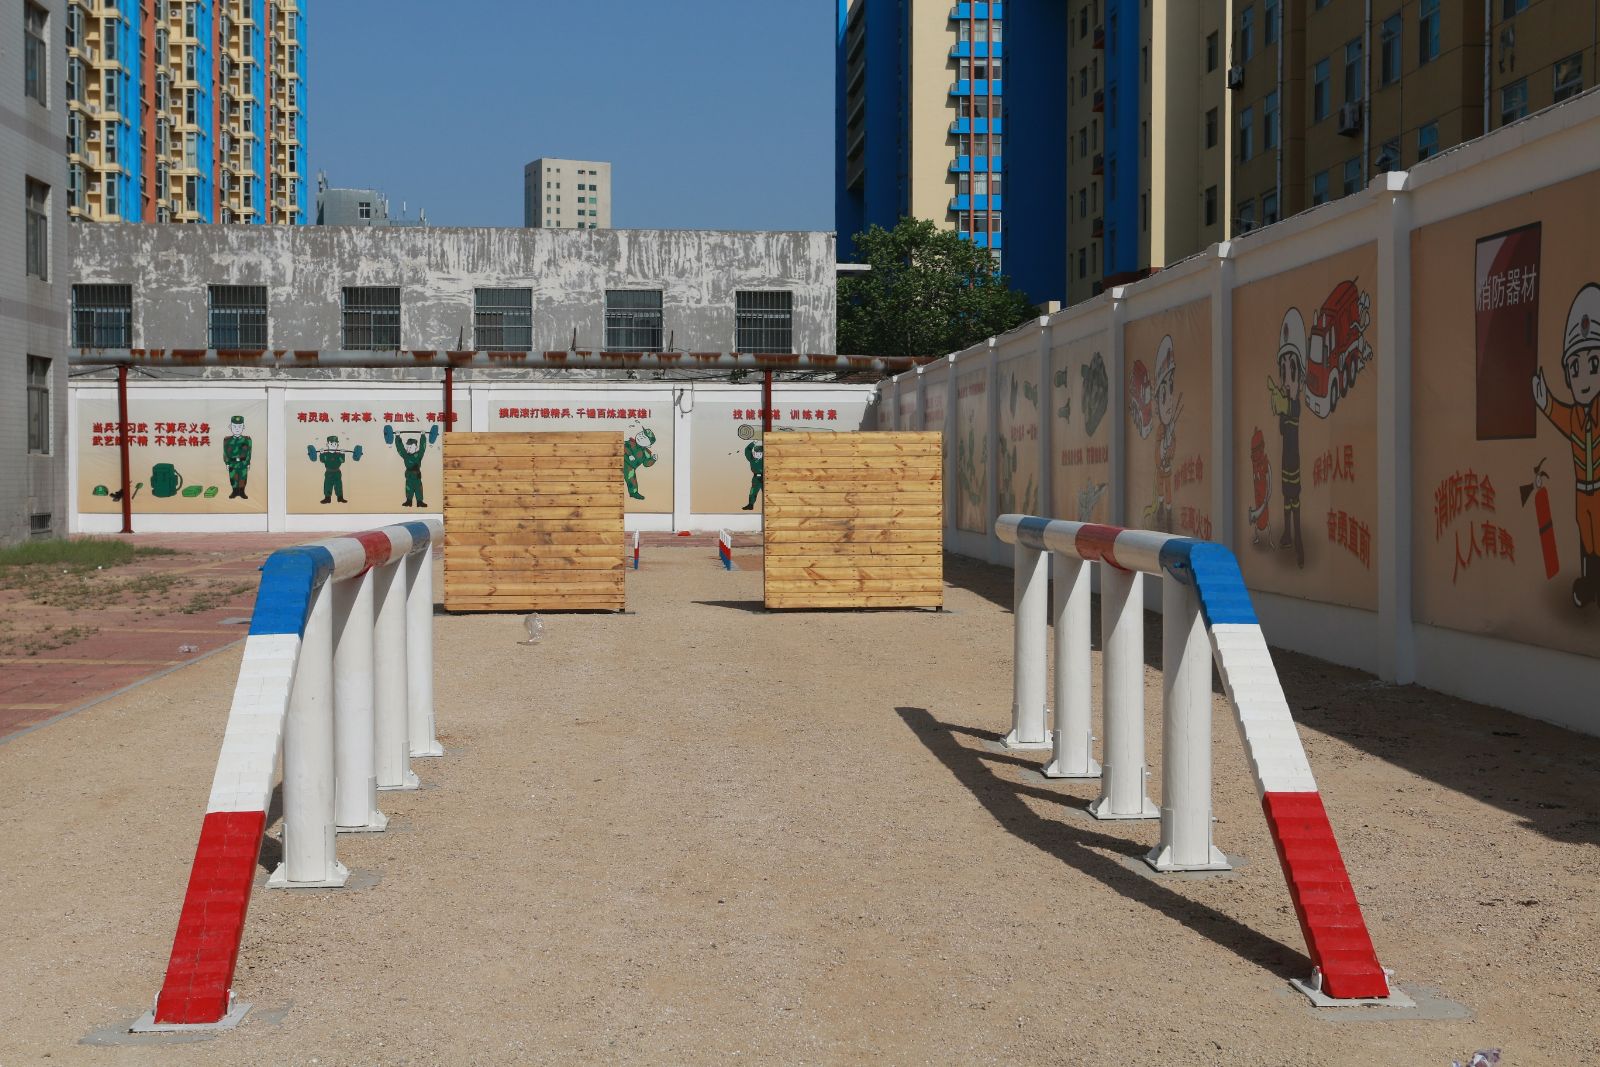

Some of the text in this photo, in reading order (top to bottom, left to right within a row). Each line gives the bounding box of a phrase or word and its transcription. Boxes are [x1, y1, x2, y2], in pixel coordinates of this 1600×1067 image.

[1477, 264, 1537, 311] 消防器材
[155, 421, 210, 434] 不算尽义务
[790, 408, 838, 421] 训练有素
[155, 435, 211, 447] 不算合格兵
[1312, 444, 1355, 487] 保护人民
[1434, 466, 1496, 542] 消防安全
[1327, 508, 1371, 568] 奋勇直前
[1453, 520, 1515, 583] 人人有责
